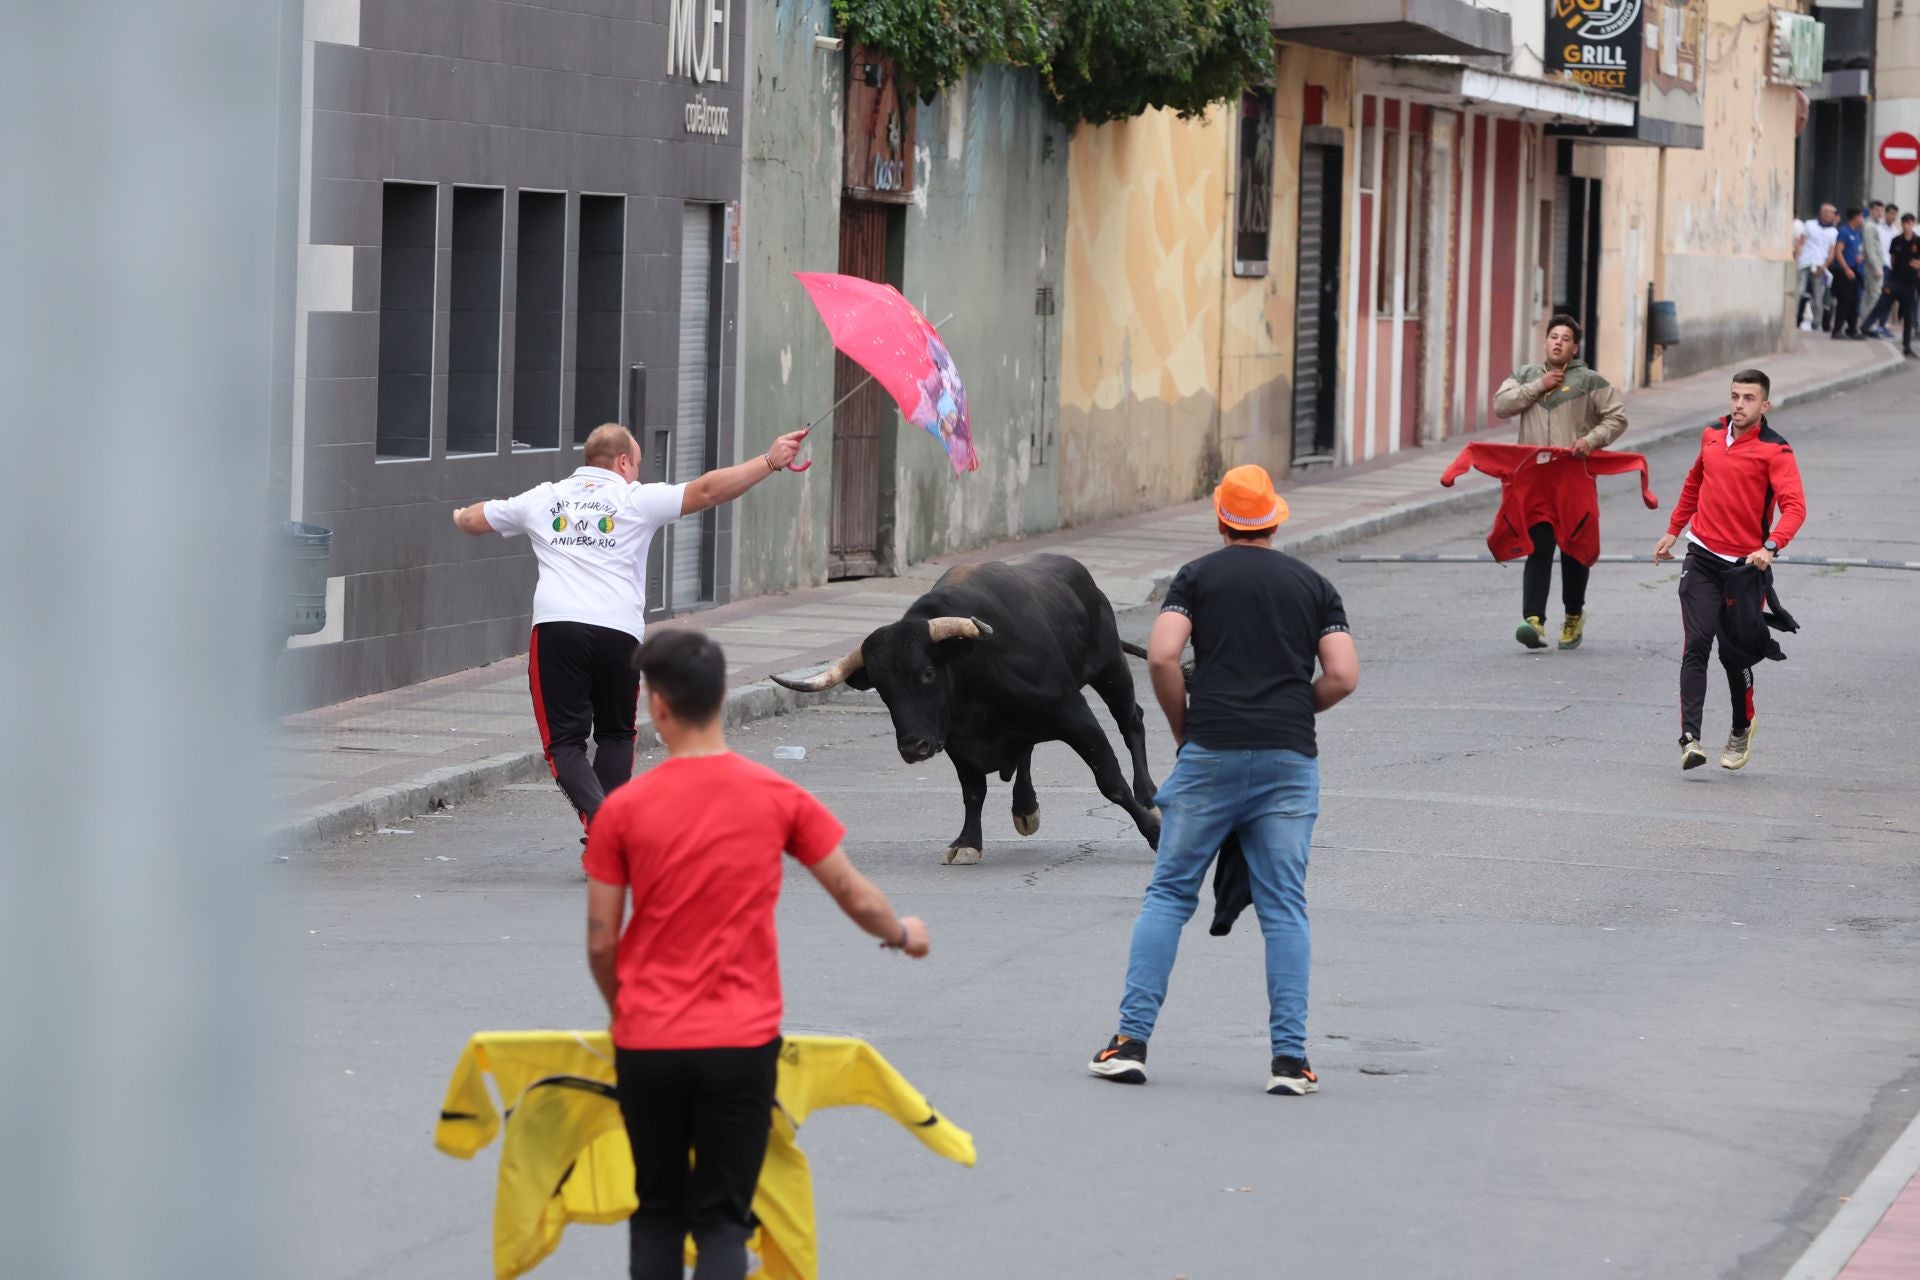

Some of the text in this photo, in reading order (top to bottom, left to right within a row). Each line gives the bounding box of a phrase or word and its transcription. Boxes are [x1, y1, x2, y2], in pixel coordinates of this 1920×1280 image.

[1563, 44, 1627, 65] GRILL
[1564, 68, 1627, 86] PROJECT
[574, 501, 618, 518] TAURINA
[550, 535, 617, 550] ANIVERSARIO
